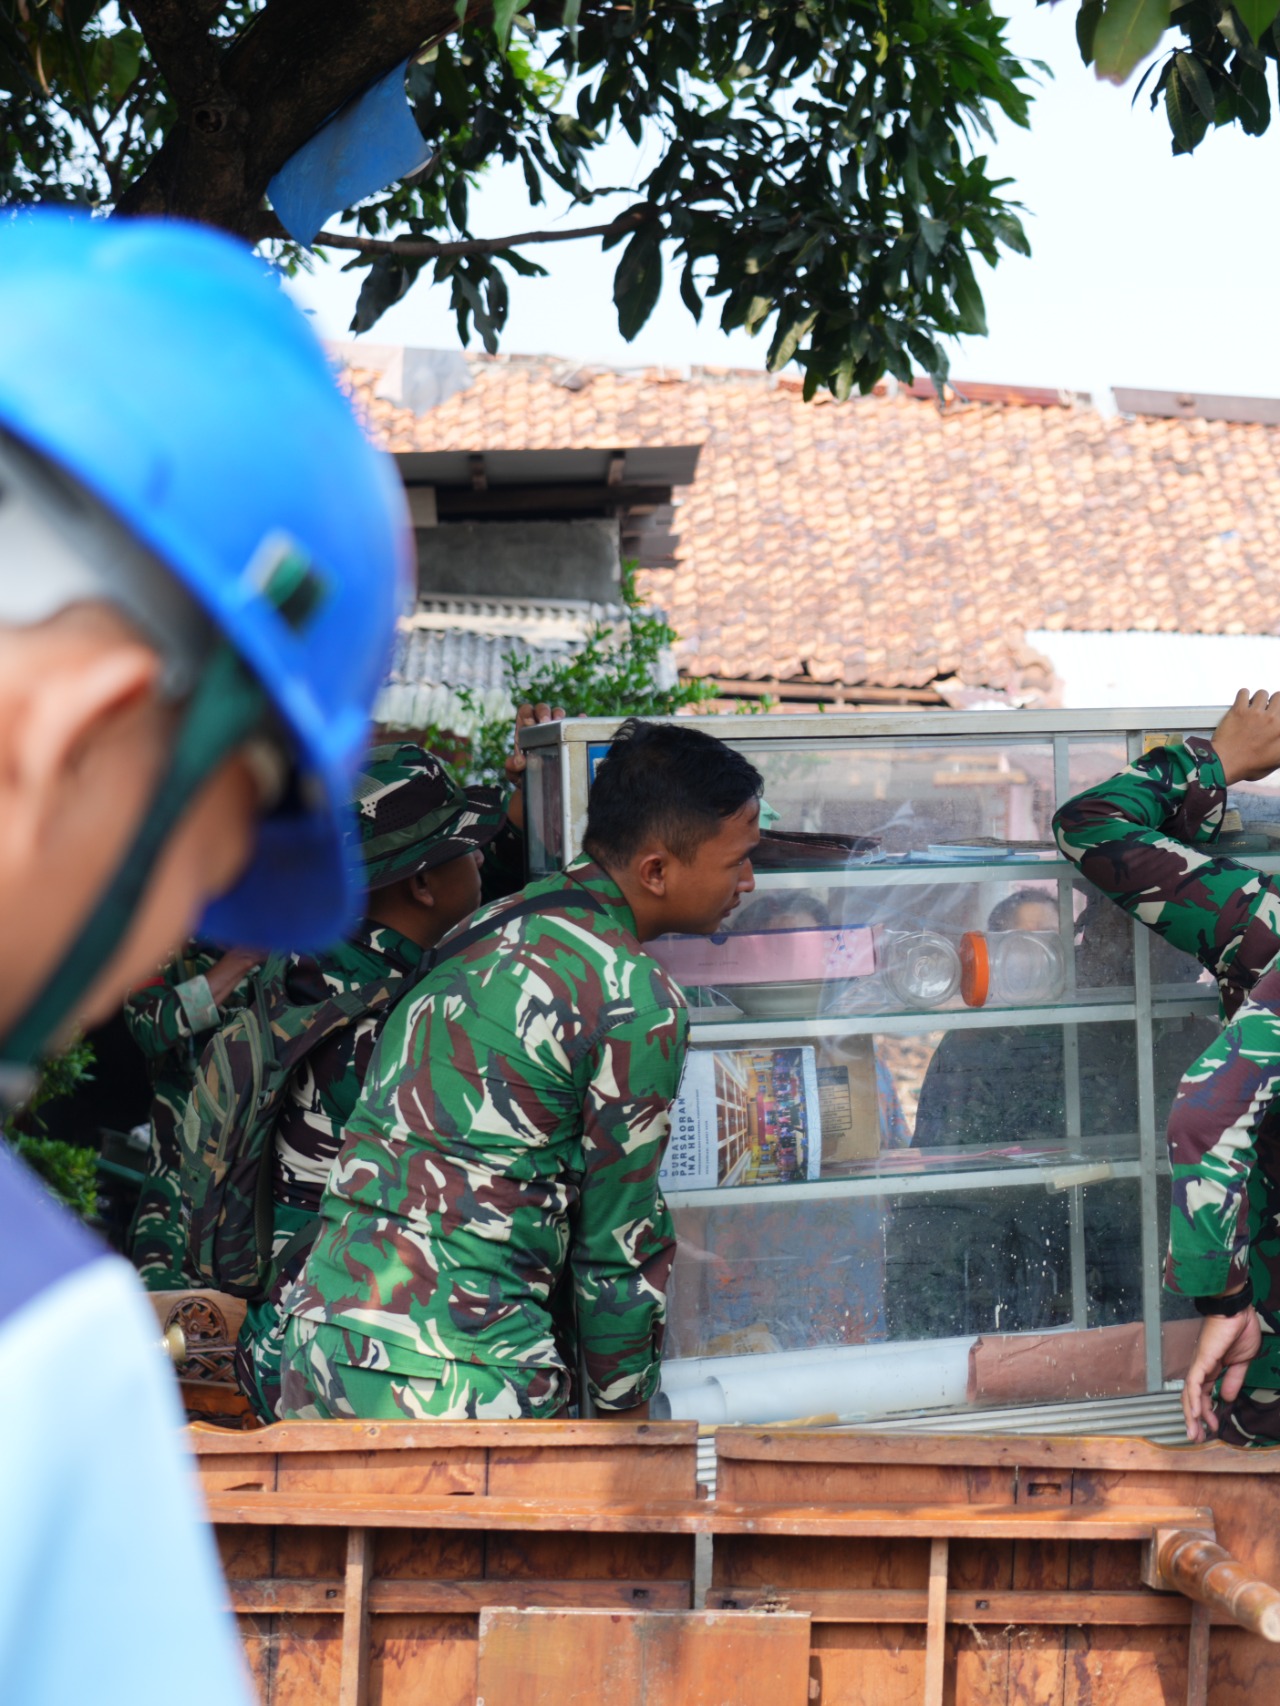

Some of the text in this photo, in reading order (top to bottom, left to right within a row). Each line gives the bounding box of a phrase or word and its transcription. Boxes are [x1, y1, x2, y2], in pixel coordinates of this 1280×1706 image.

[672, 1135, 680, 1176] SURAT
[678, 1098, 687, 1177] PARSAORAN
[688, 1116, 696, 1176] INA HKBP
